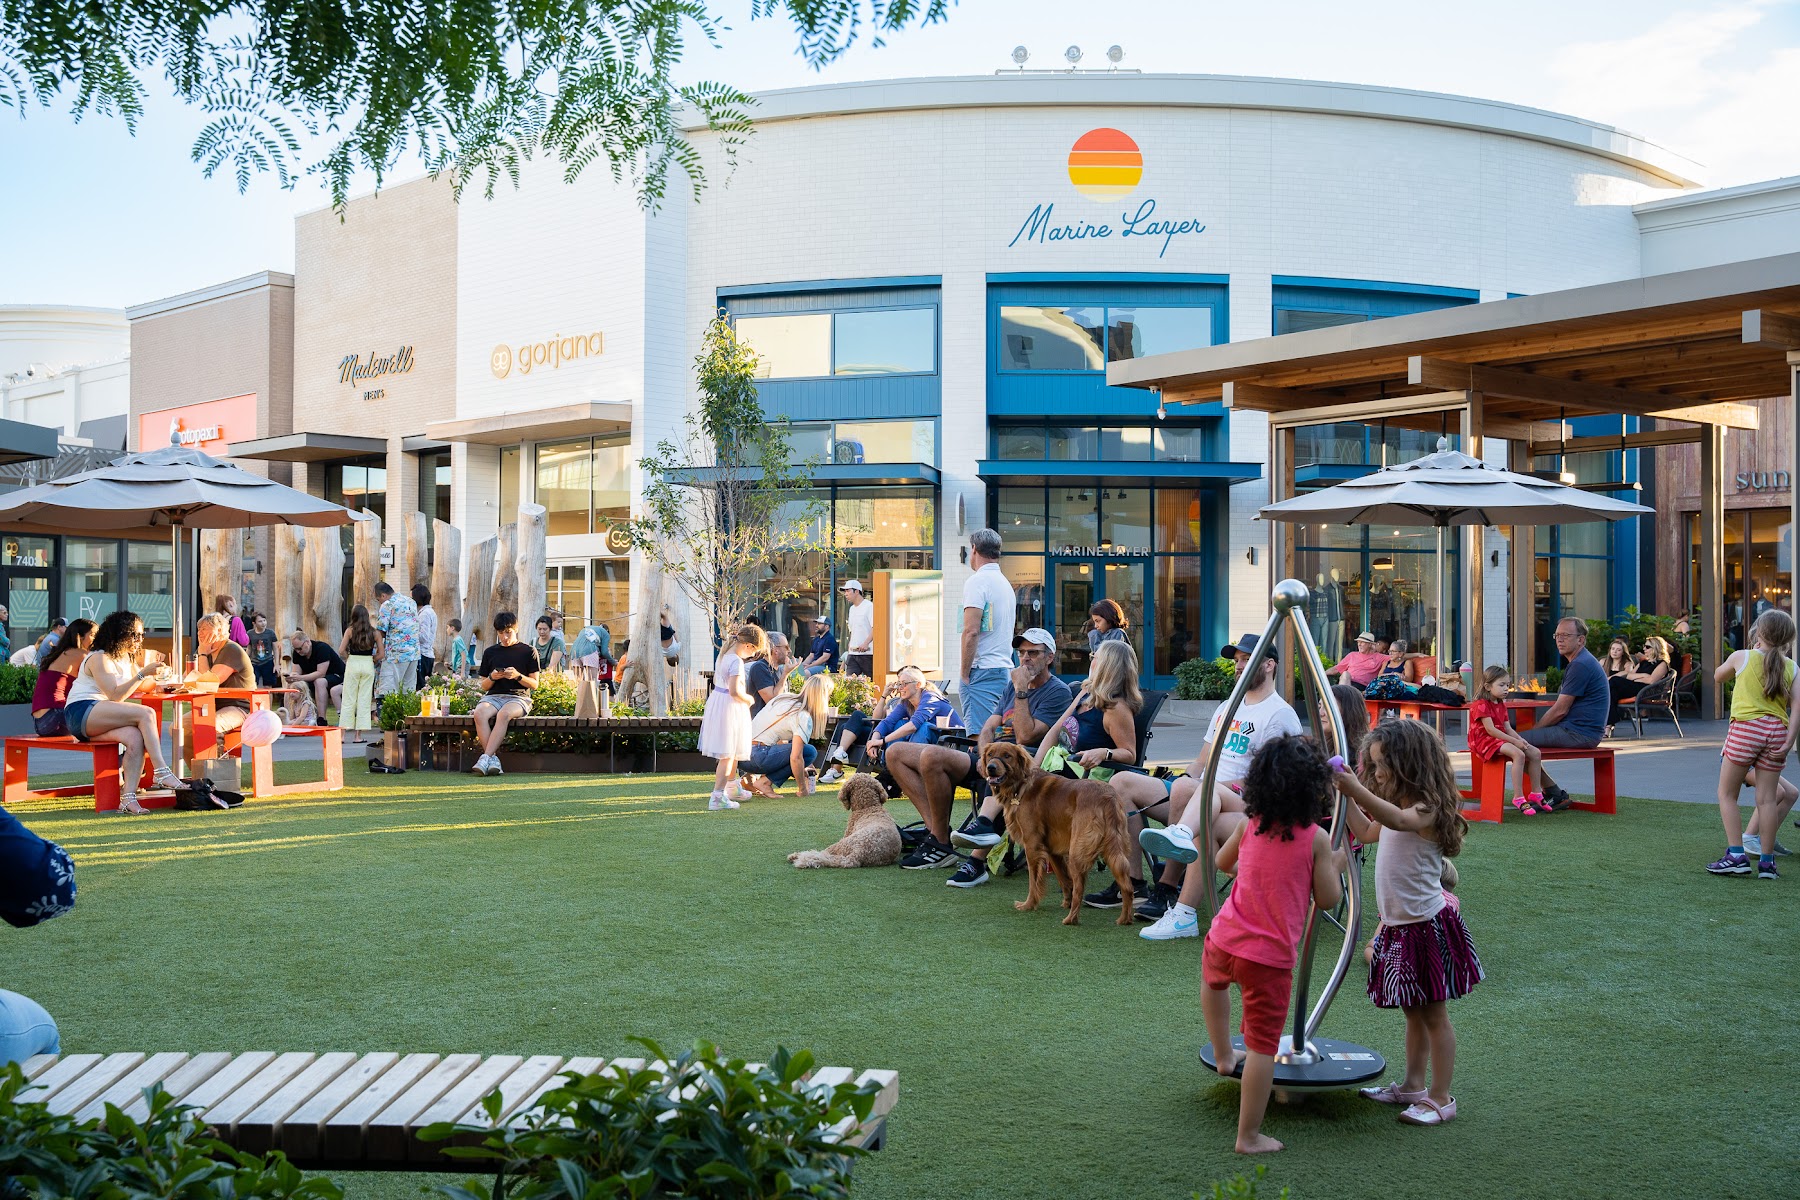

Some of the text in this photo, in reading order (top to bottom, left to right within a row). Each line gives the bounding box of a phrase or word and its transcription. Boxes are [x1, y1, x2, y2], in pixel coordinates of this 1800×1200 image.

[1008, 199, 1206, 258] Marine Layer
[338, 345, 414, 388] Madewell
[519, 331, 603, 375] gorjana
[177, 424, 220, 448] otopaxi
[1051, 546, 1149, 557] MARINE LAYER
